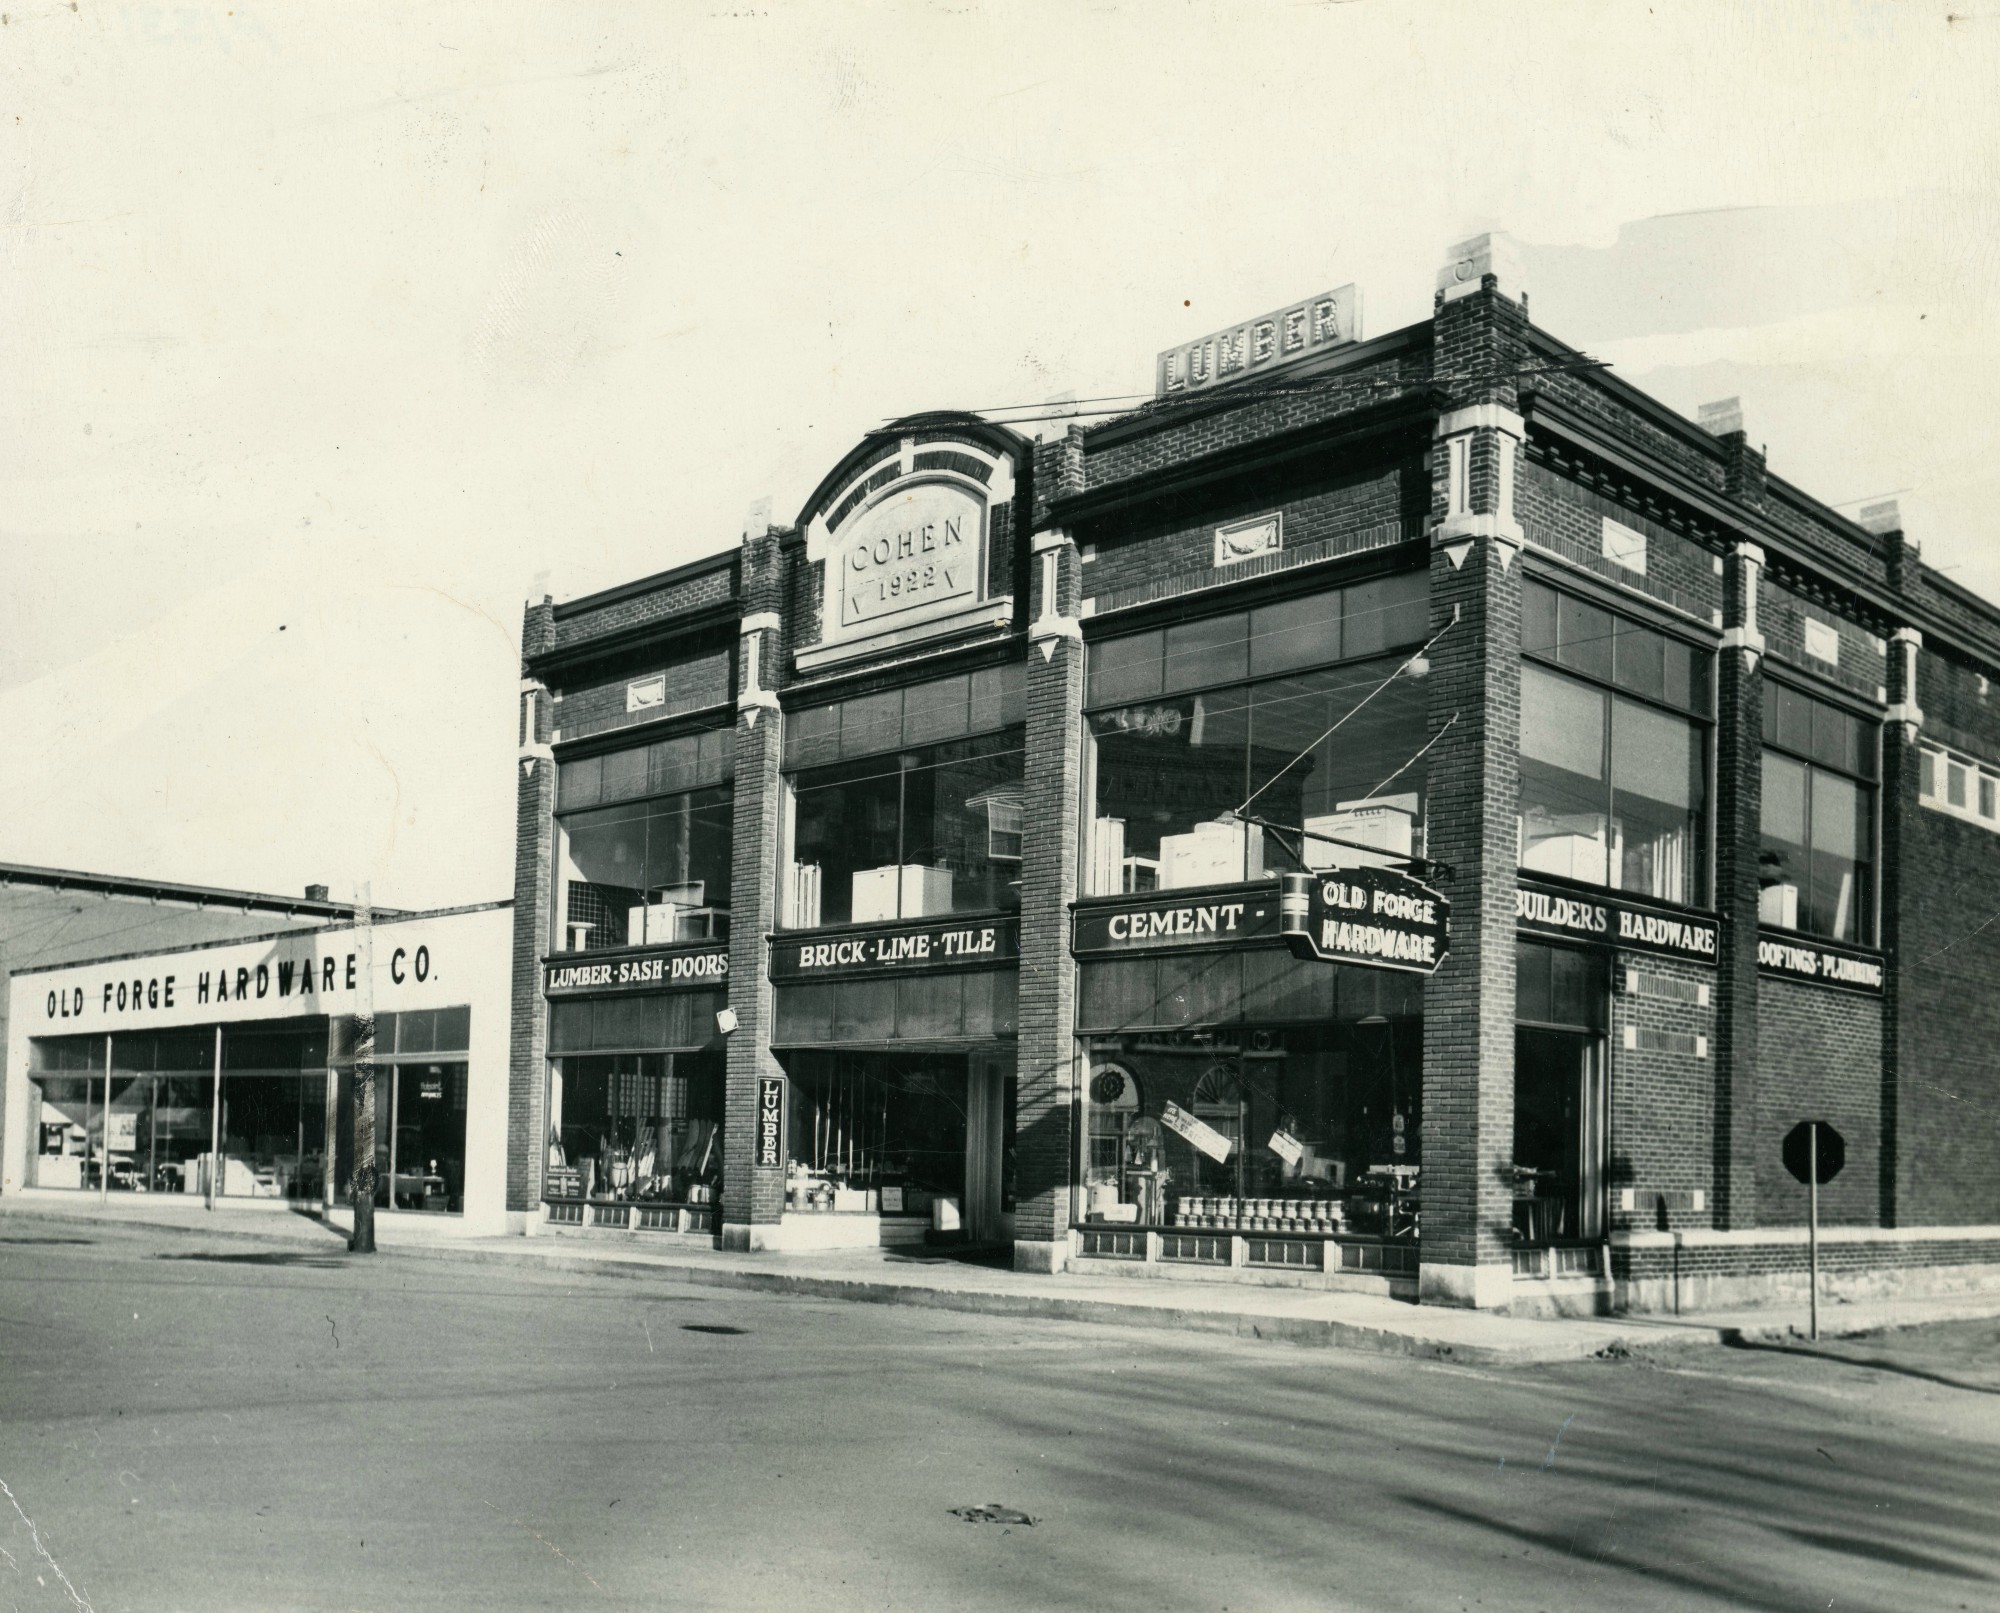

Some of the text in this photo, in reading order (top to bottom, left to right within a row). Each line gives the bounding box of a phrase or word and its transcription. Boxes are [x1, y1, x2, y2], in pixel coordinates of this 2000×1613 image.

[1166, 298, 1339, 392] LUMBER
[852, 516, 961, 571] COHEN
[880, 566, 936, 601] 1922
[1108, 903, 1244, 940] CEMENT
[1322, 881, 1437, 925] OLD FORGE
[1321, 919, 1436, 964] HARDWARE
[1619, 911, 1715, 954] HARDWARE
[1757, 941, 1816, 974] OOFINGS
[48, 945, 438, 1019] OLD FORGE HARDWARE CO.
[761, 1081, 780, 1163] LUMBER
